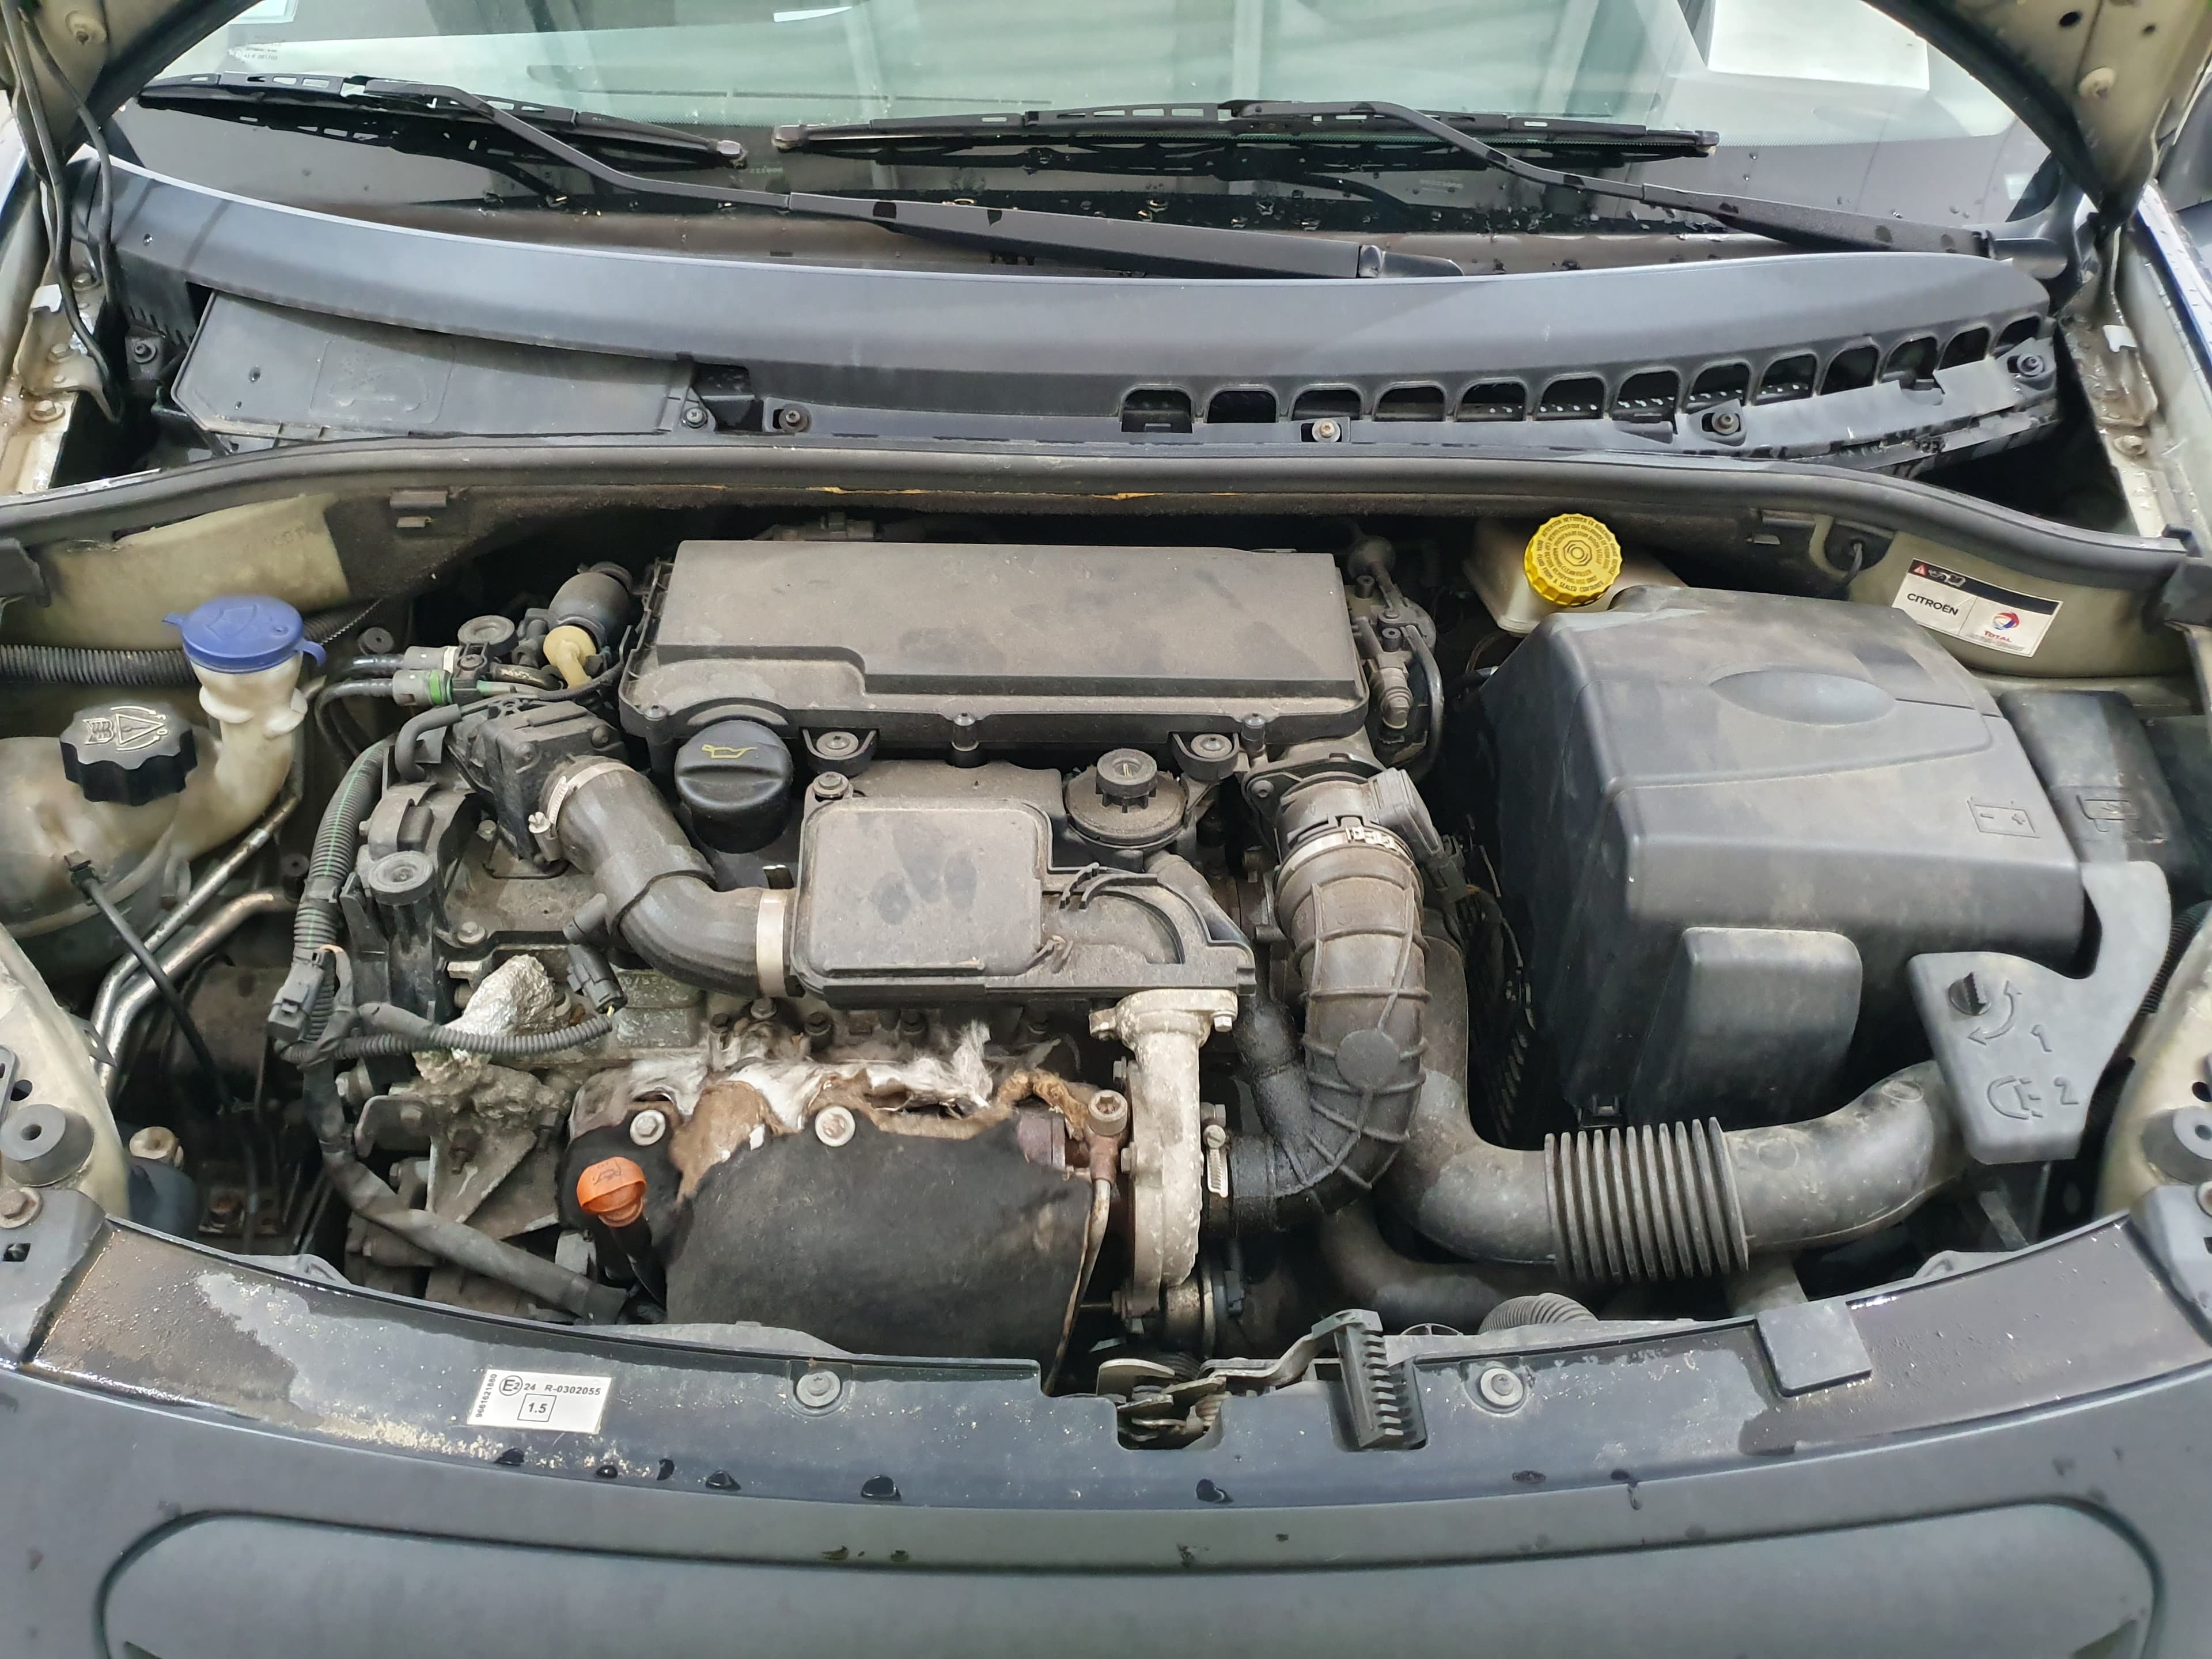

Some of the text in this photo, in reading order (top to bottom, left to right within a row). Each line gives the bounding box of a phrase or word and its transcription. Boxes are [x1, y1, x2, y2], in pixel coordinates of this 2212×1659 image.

[1907, 593, 1959, 616] CITROËN
[1984, 630, 2012, 642] TOTAL
[2031, 1024, 2052, 1052] 1
[2054, 1076, 2079, 1105] 2
[544, 1384, 601, 1396] R-0302055
[528, 1402, 548, 1414] 1.5
